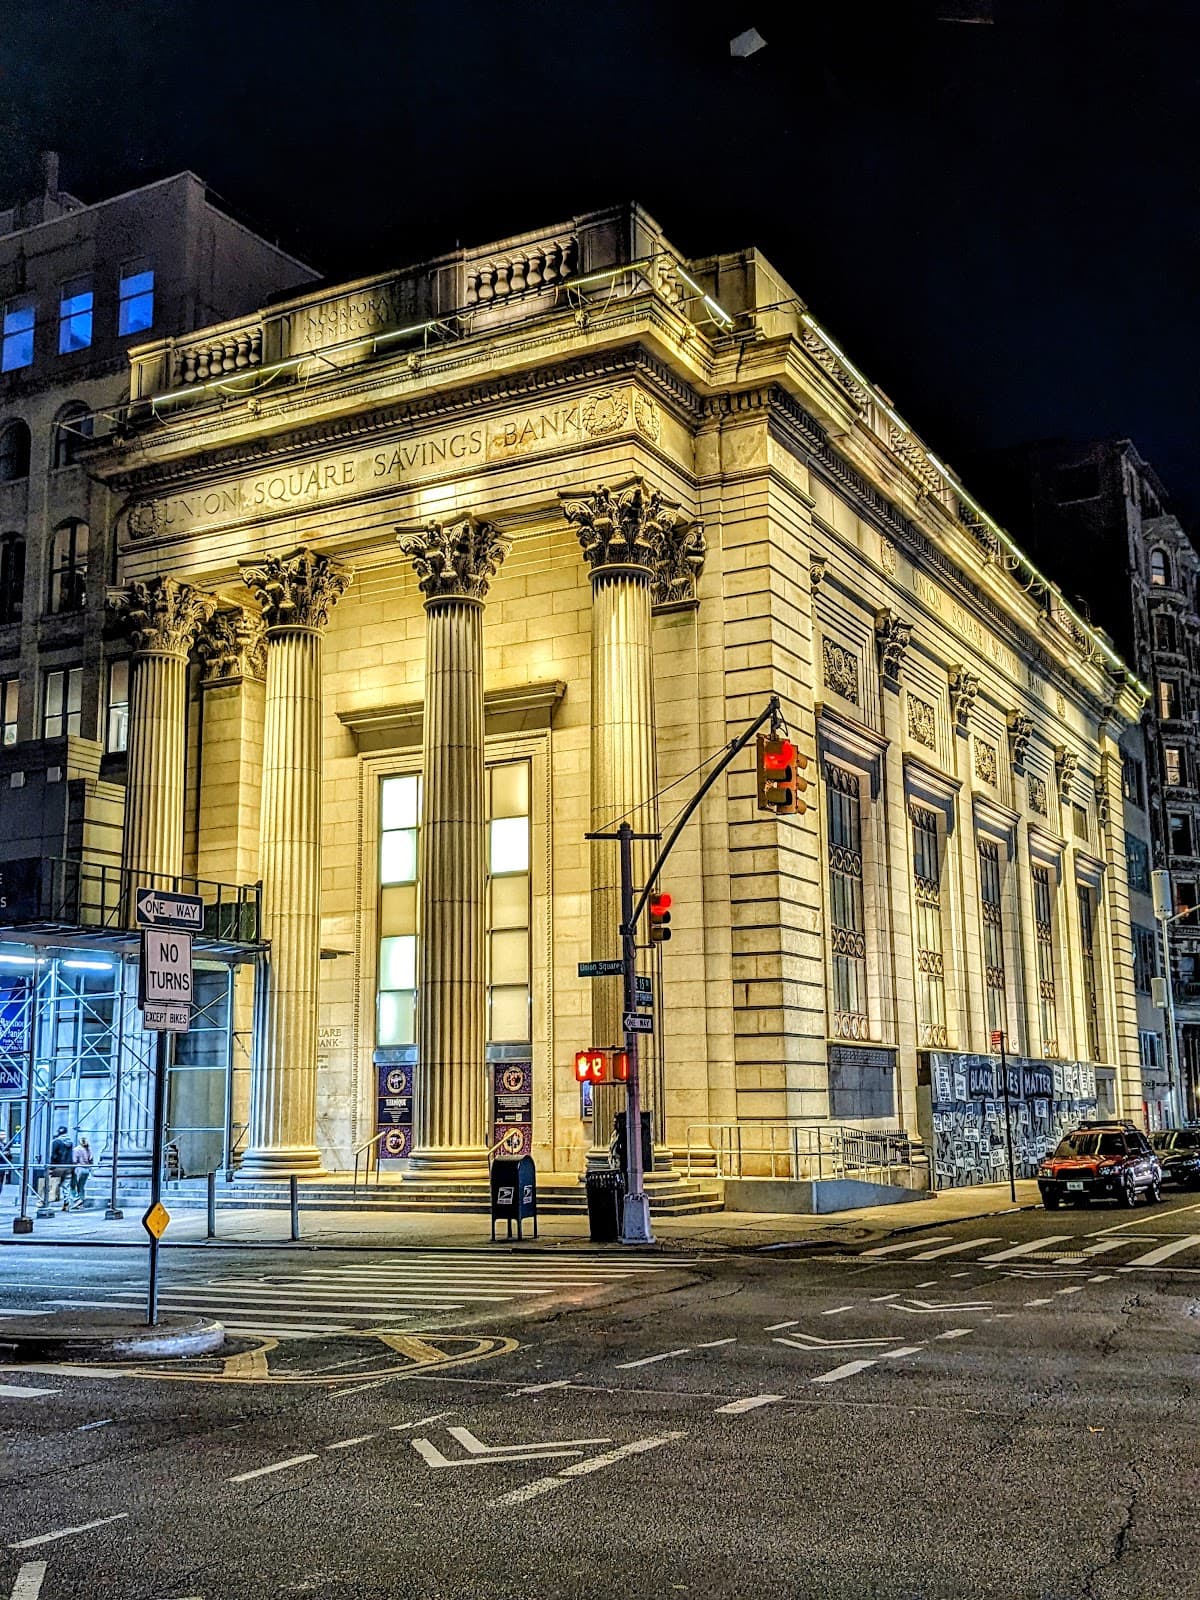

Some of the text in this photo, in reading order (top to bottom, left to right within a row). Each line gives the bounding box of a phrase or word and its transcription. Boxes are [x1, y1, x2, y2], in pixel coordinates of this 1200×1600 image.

[163, 407, 583, 525] UNION SQUARE SAVINGS BANK
[911, 568, 942, 611] UNION
[145, 900, 198, 919] ONE WAY
[160, 943, 179, 963] NO
[580, 962, 620, 972] Union Square
[149, 970, 190, 991] TURNS
[145, 1011, 187, 1024] EXCEPT BIKES
[626, 1018, 650, 1028] ONE WAY
[970, 1069, 994, 1093] BLACK
[1024, 1071, 1051, 1093] MATTER
